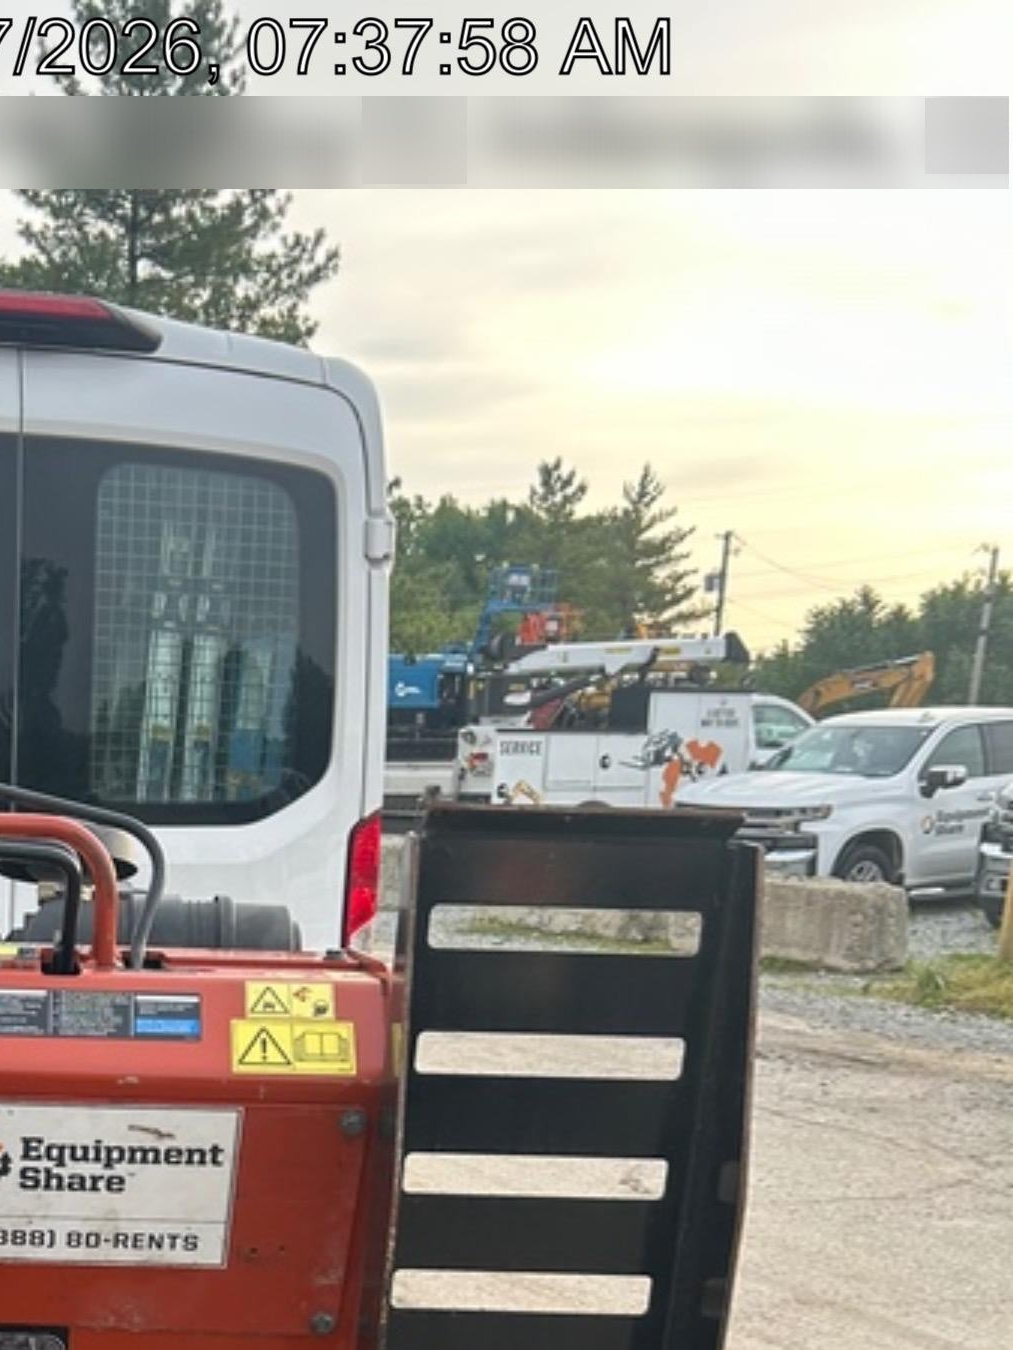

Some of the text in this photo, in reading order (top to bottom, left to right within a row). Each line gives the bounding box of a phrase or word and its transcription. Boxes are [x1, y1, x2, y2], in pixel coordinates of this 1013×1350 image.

[19, 1136, 225, 1170] Equipment
[18, 1166, 127, 1193] Share
[65, 1230, 200, 1252] 80-RENTS
